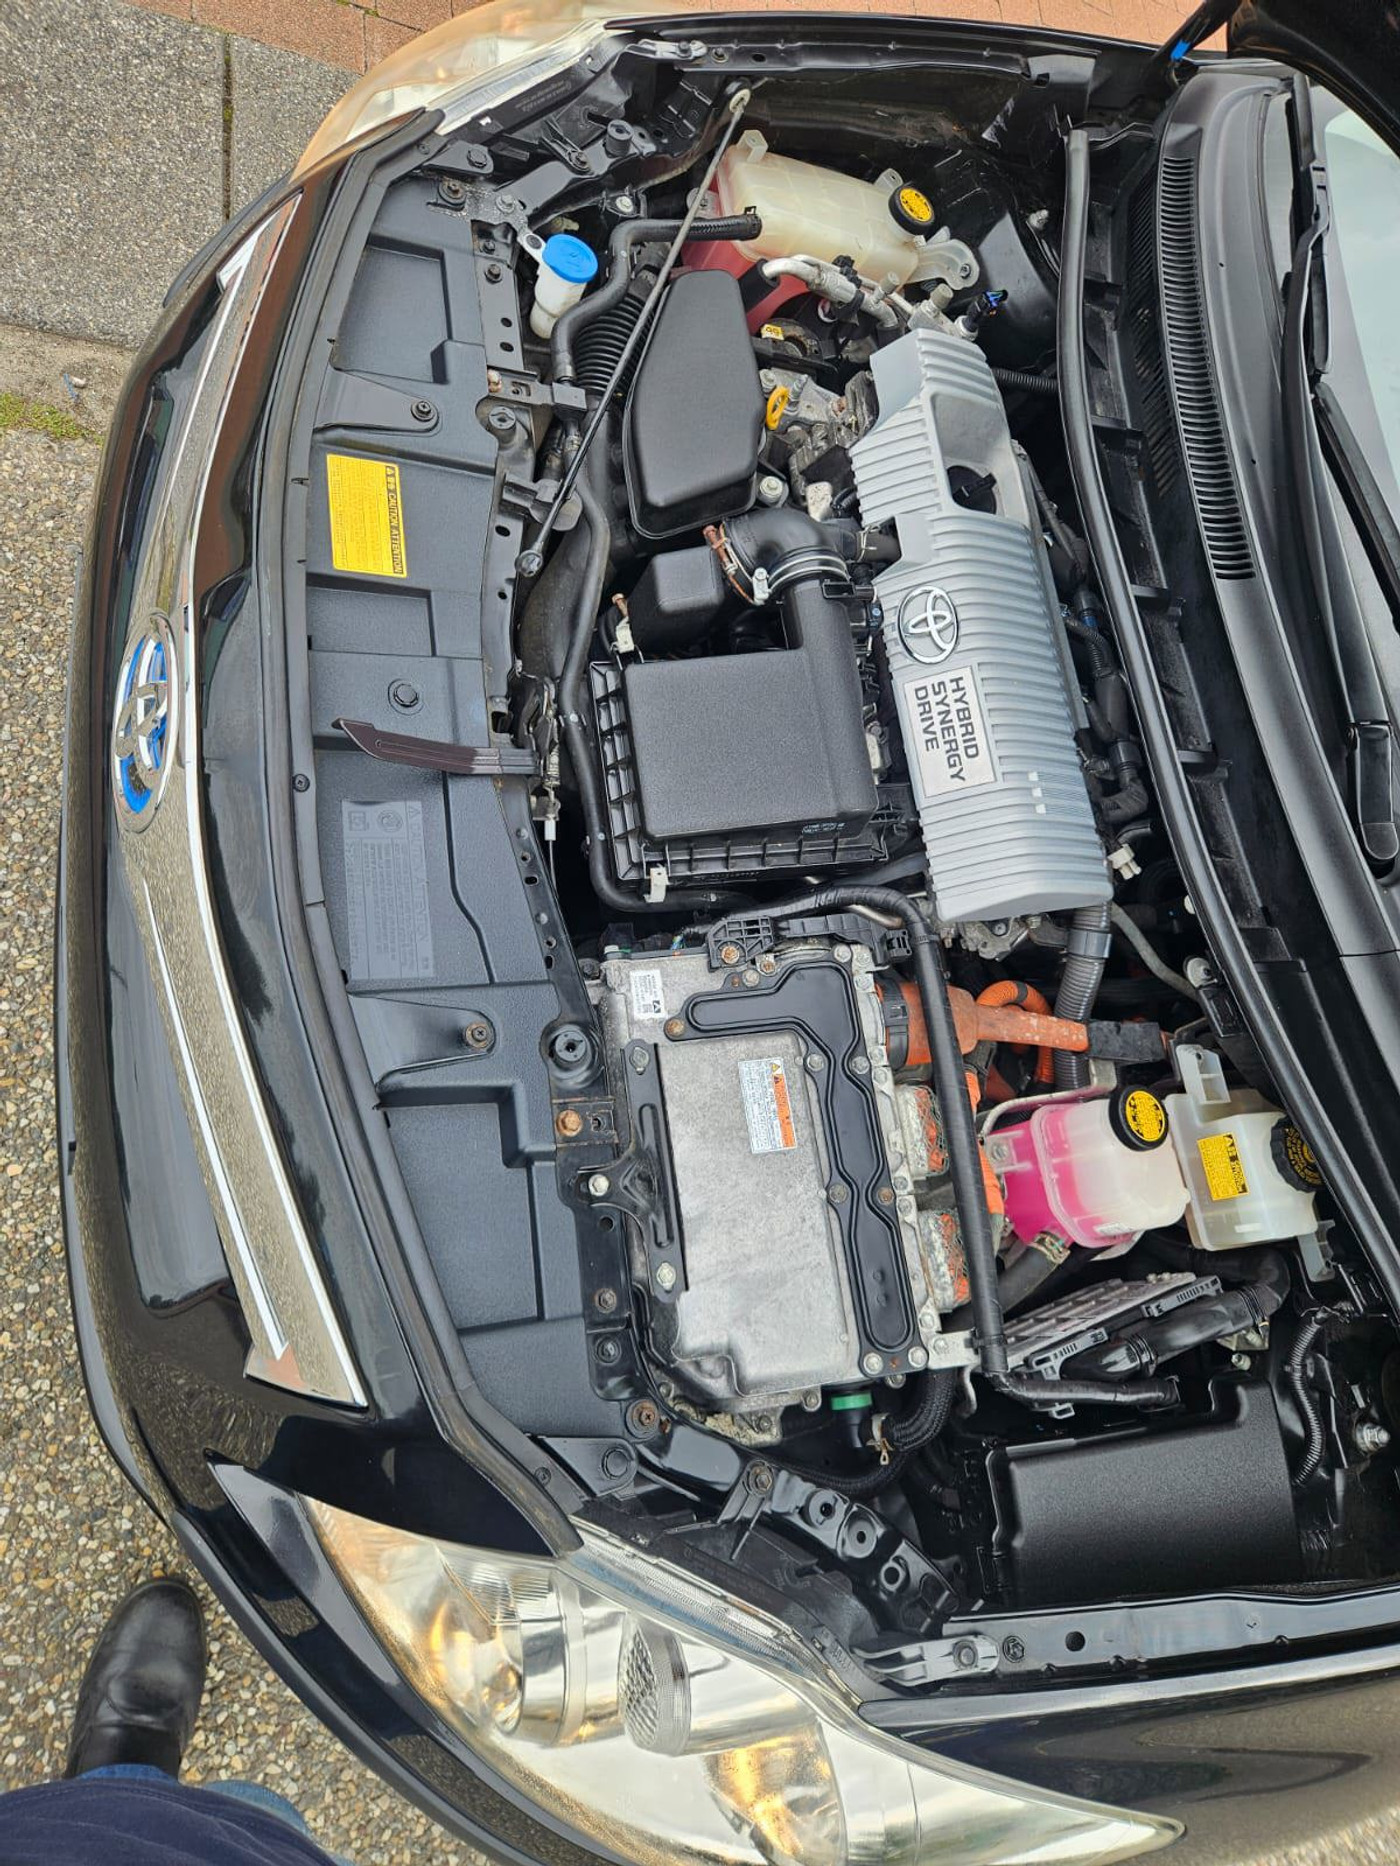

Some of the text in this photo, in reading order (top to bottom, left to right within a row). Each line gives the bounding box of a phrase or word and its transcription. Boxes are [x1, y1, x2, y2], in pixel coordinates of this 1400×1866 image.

[388, 493, 399, 526] CAUTION
[391, 529, 403, 573] ATTENTION
[915, 686, 939, 752] DRIVE
[932, 681, 965, 781] SYNERGY
[950, 677, 979, 759] HYBRID
[413, 876, 428, 942] ATTENTION
